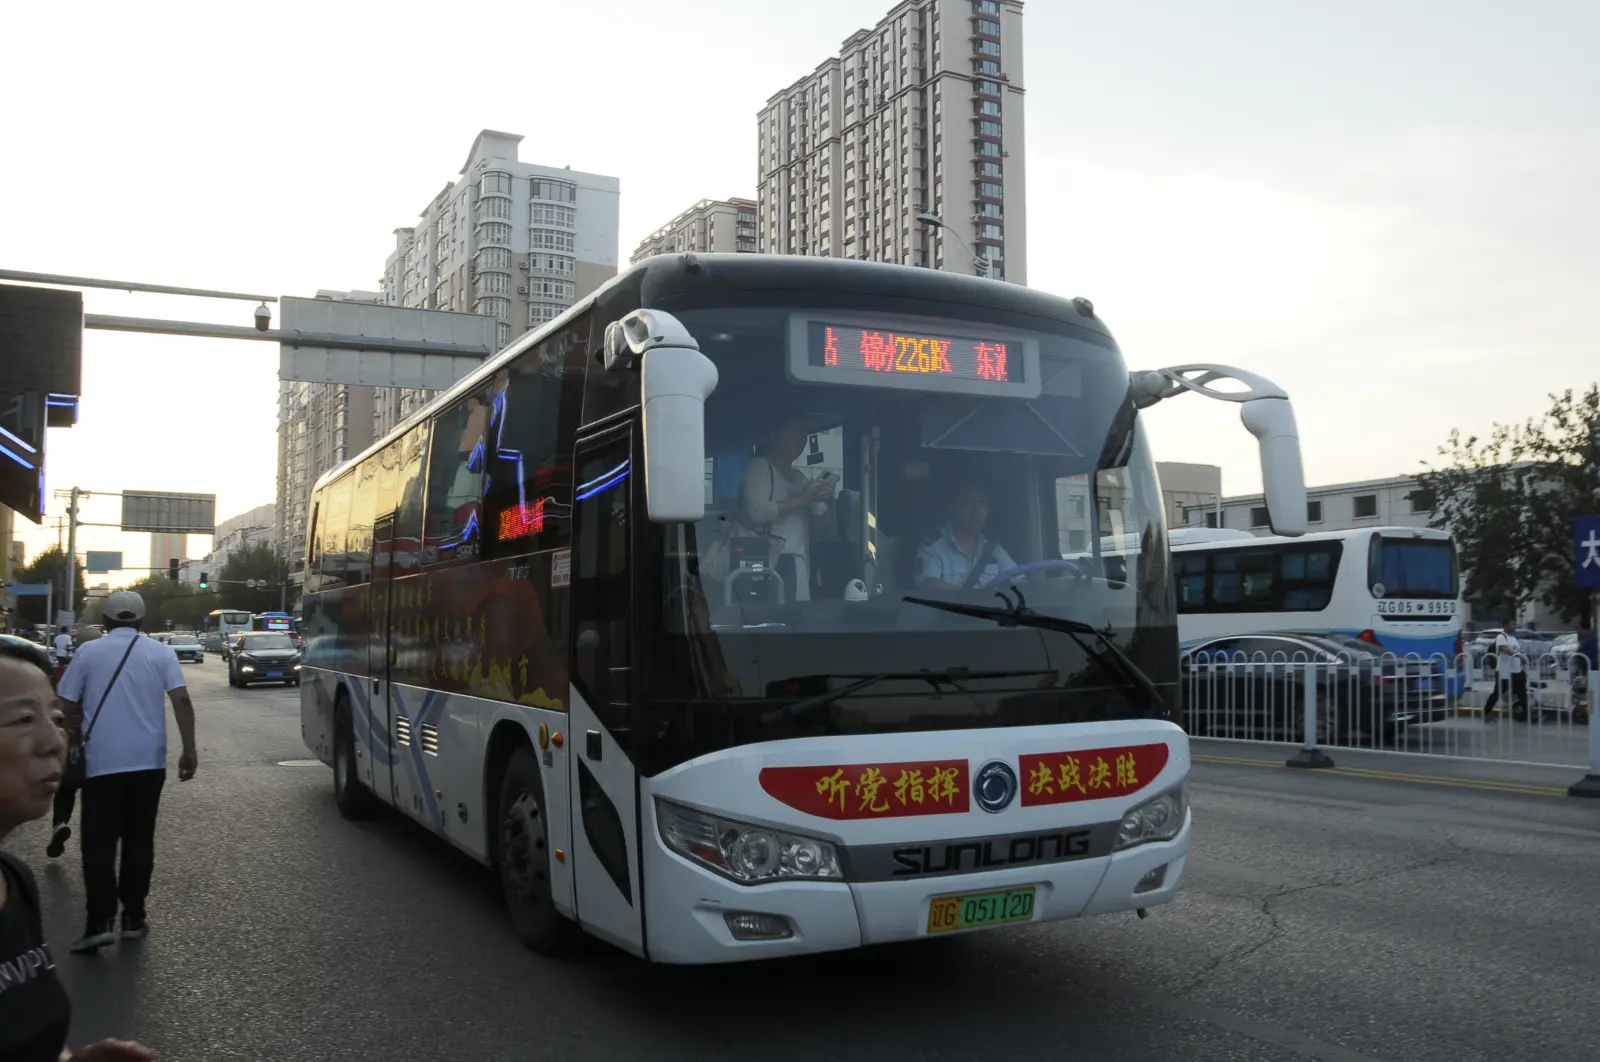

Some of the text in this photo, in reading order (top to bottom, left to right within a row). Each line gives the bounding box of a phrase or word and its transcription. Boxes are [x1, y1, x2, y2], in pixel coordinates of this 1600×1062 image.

[815, 752, 1139, 813] 听党指挥 决战决胜
[892, 830, 1091, 875] SUNLONG
